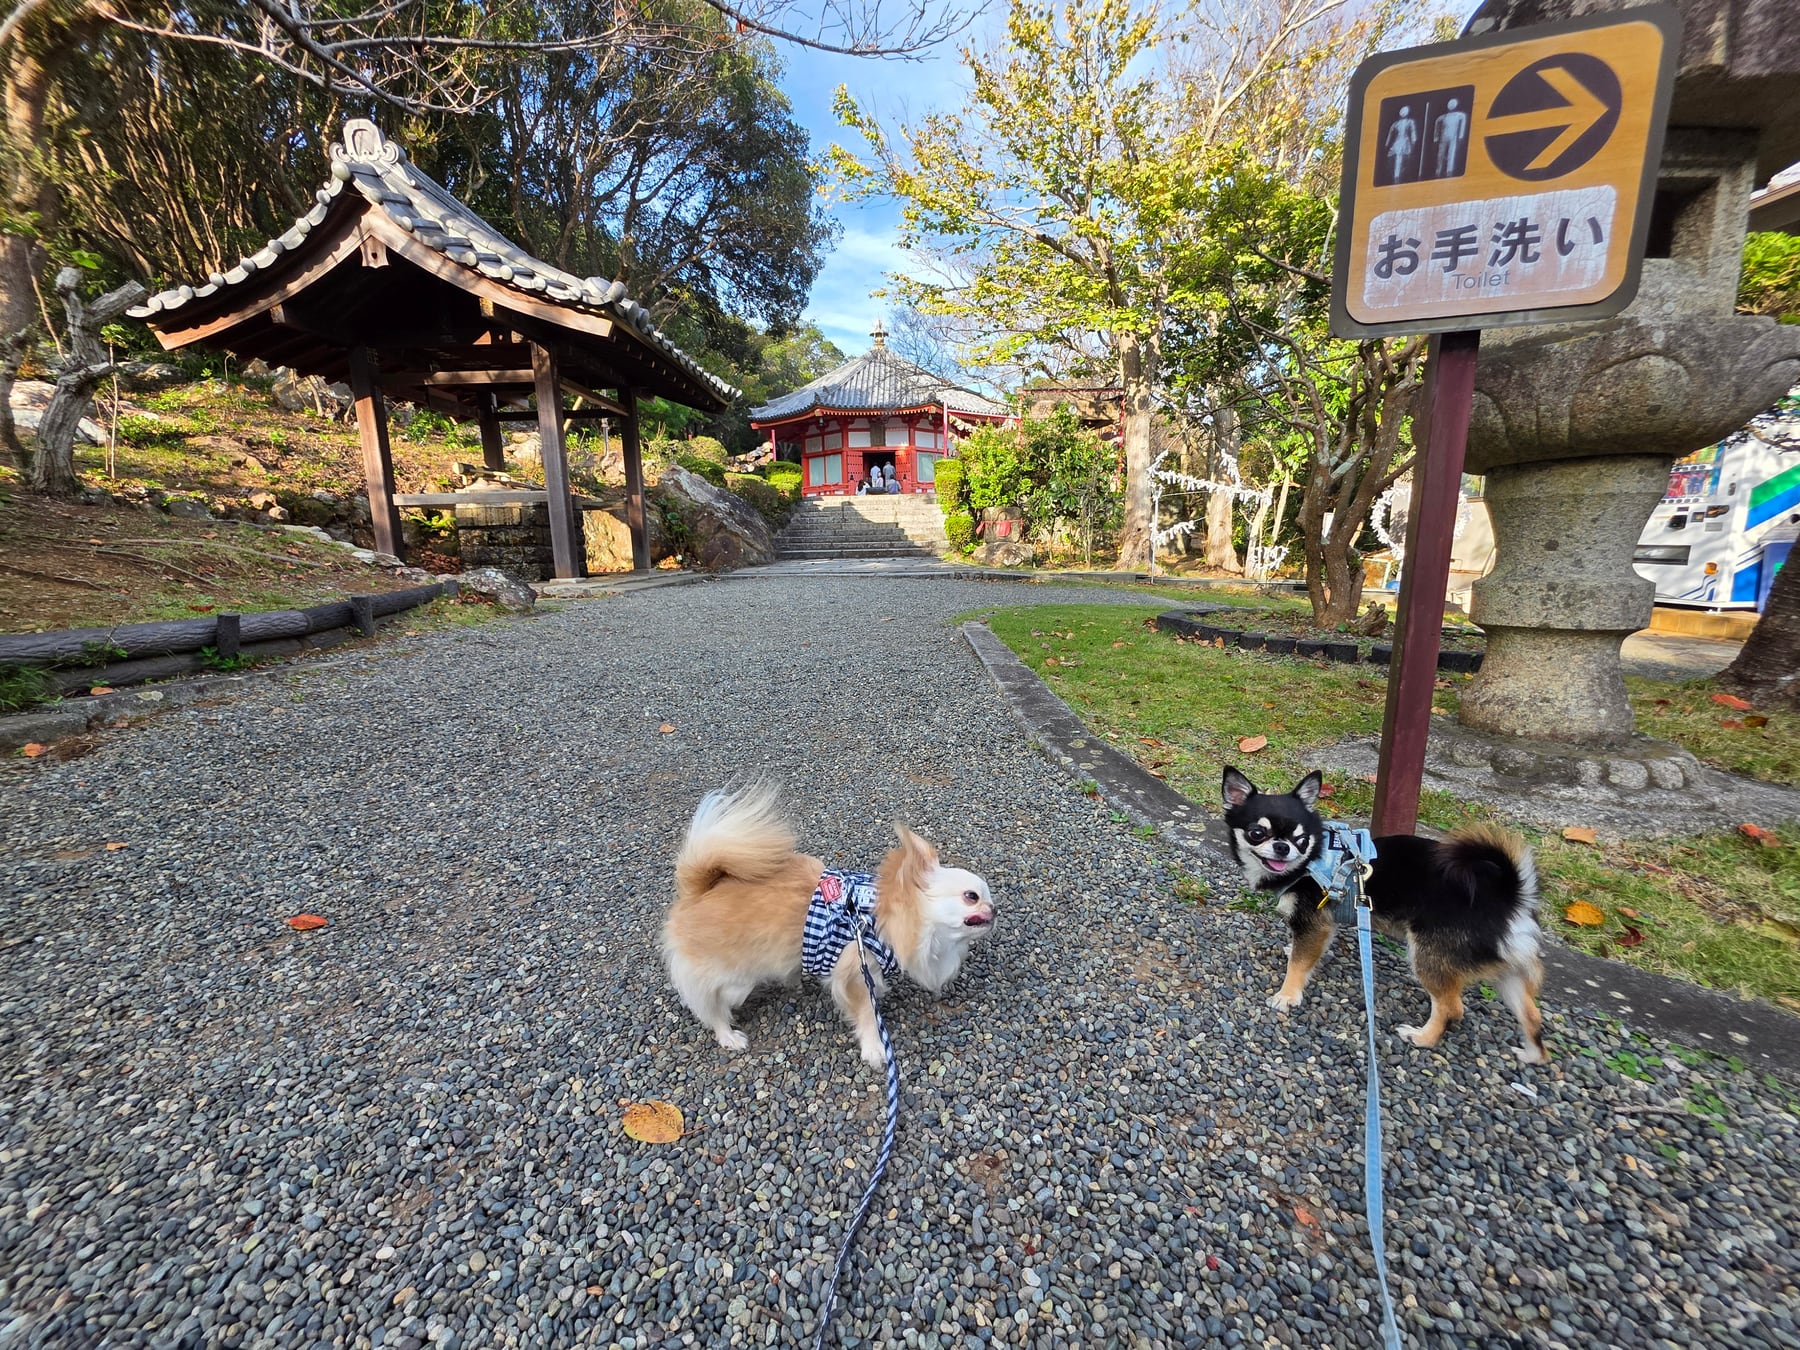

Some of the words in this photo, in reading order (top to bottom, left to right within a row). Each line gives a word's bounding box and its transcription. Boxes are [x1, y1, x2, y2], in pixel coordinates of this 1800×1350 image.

[1373, 216, 1604, 279] お手洗い
[1452, 270, 1511, 290] Toilet
